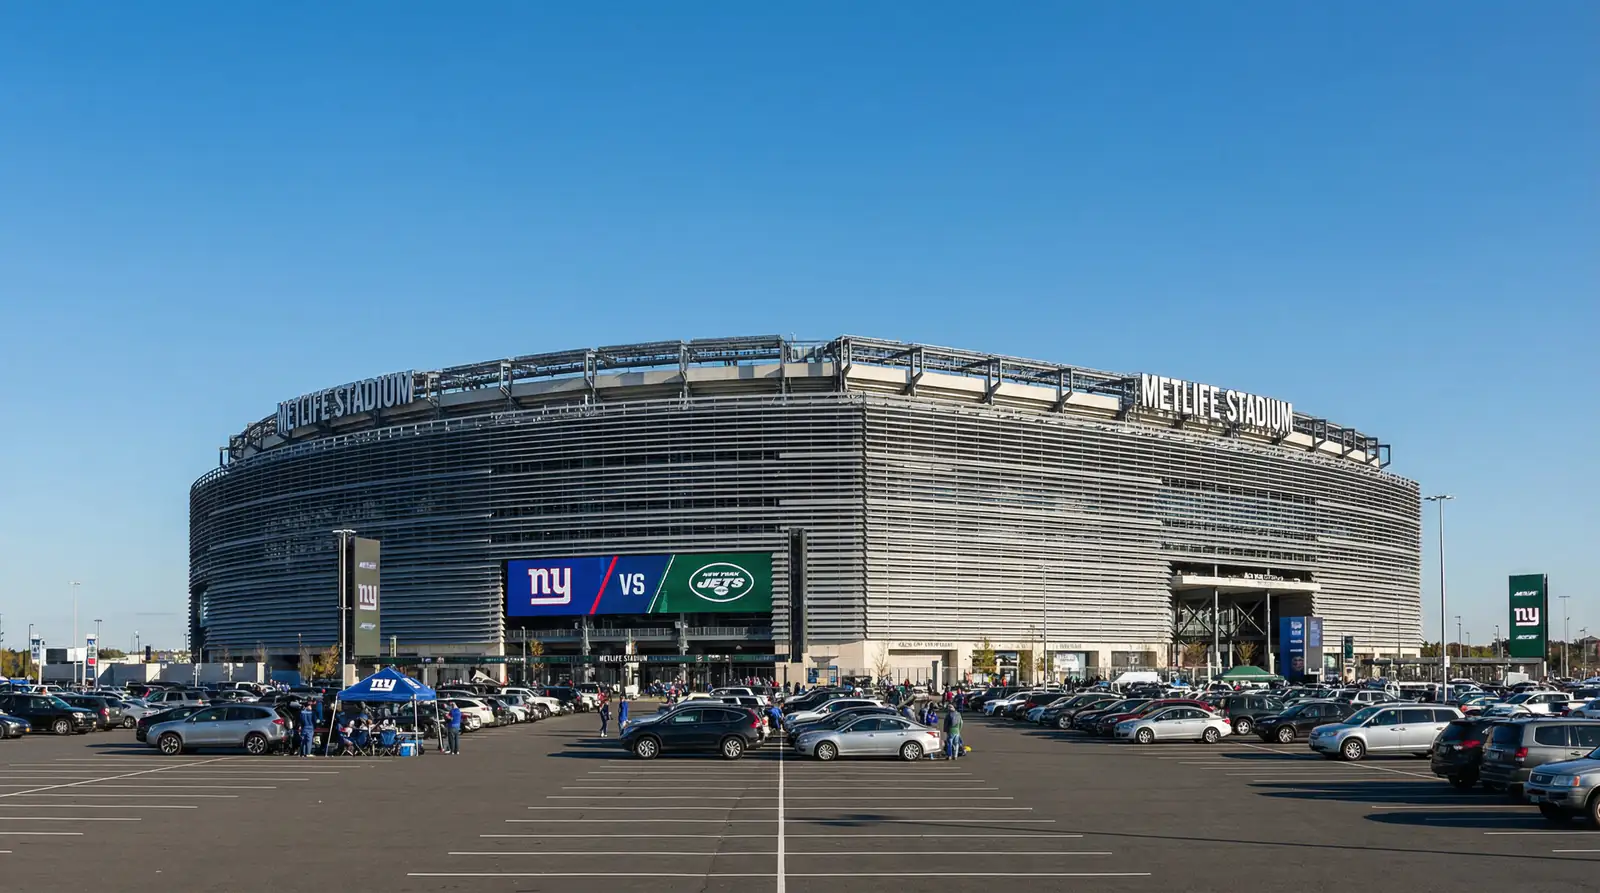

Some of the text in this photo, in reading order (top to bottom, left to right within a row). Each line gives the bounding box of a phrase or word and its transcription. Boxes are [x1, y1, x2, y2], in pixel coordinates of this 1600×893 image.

[277, 369, 414, 434] METLIFE STADIUM
[1141, 372, 1293, 433] METLIFE STADIUM
[527, 567, 571, 605] ny
[618, 572, 645, 596] VS
[696, 577, 746, 589] JETS
[369, 678, 397, 692] ny
